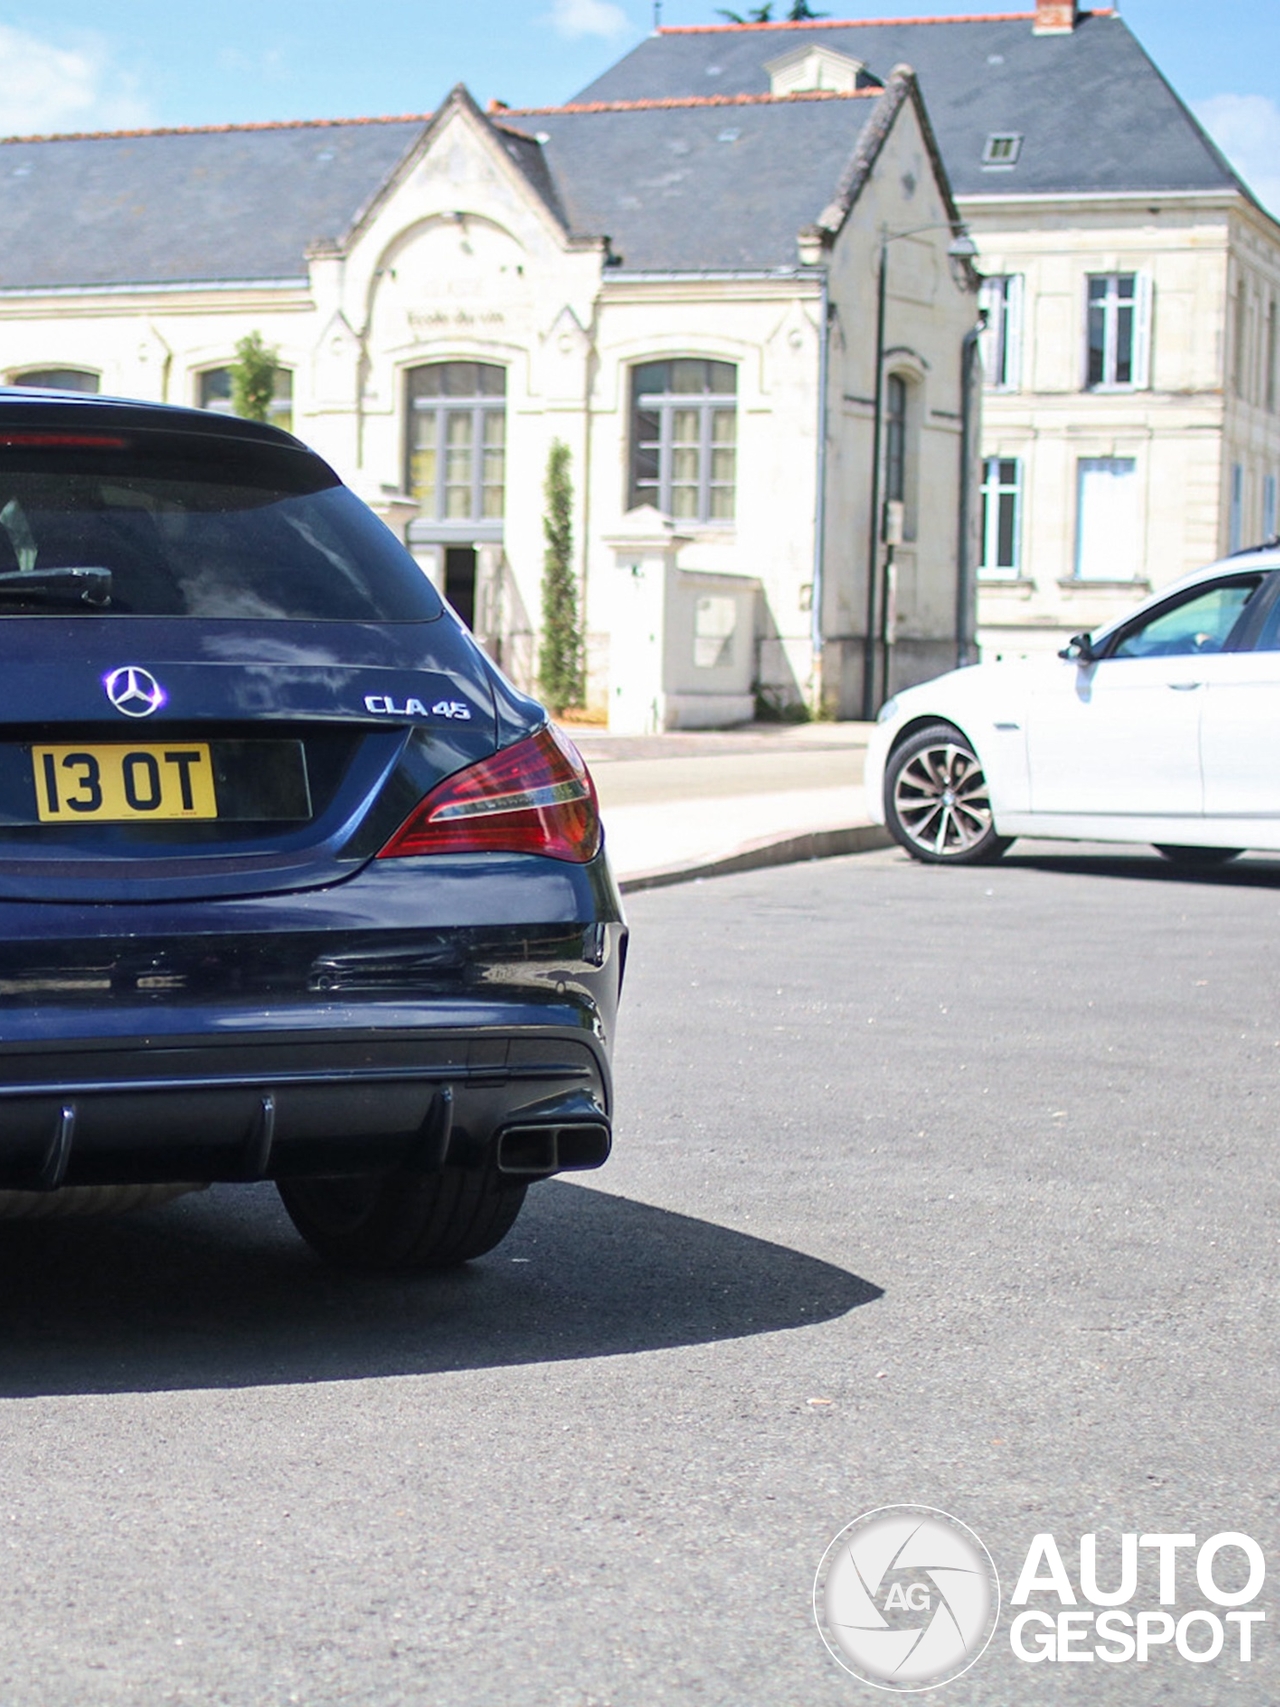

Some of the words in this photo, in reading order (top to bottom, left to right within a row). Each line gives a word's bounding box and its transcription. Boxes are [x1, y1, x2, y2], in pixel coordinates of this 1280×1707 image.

[363, 695, 429, 717] CLA
[431, 701, 471, 720] 45
[121, 750, 202, 812] OT
